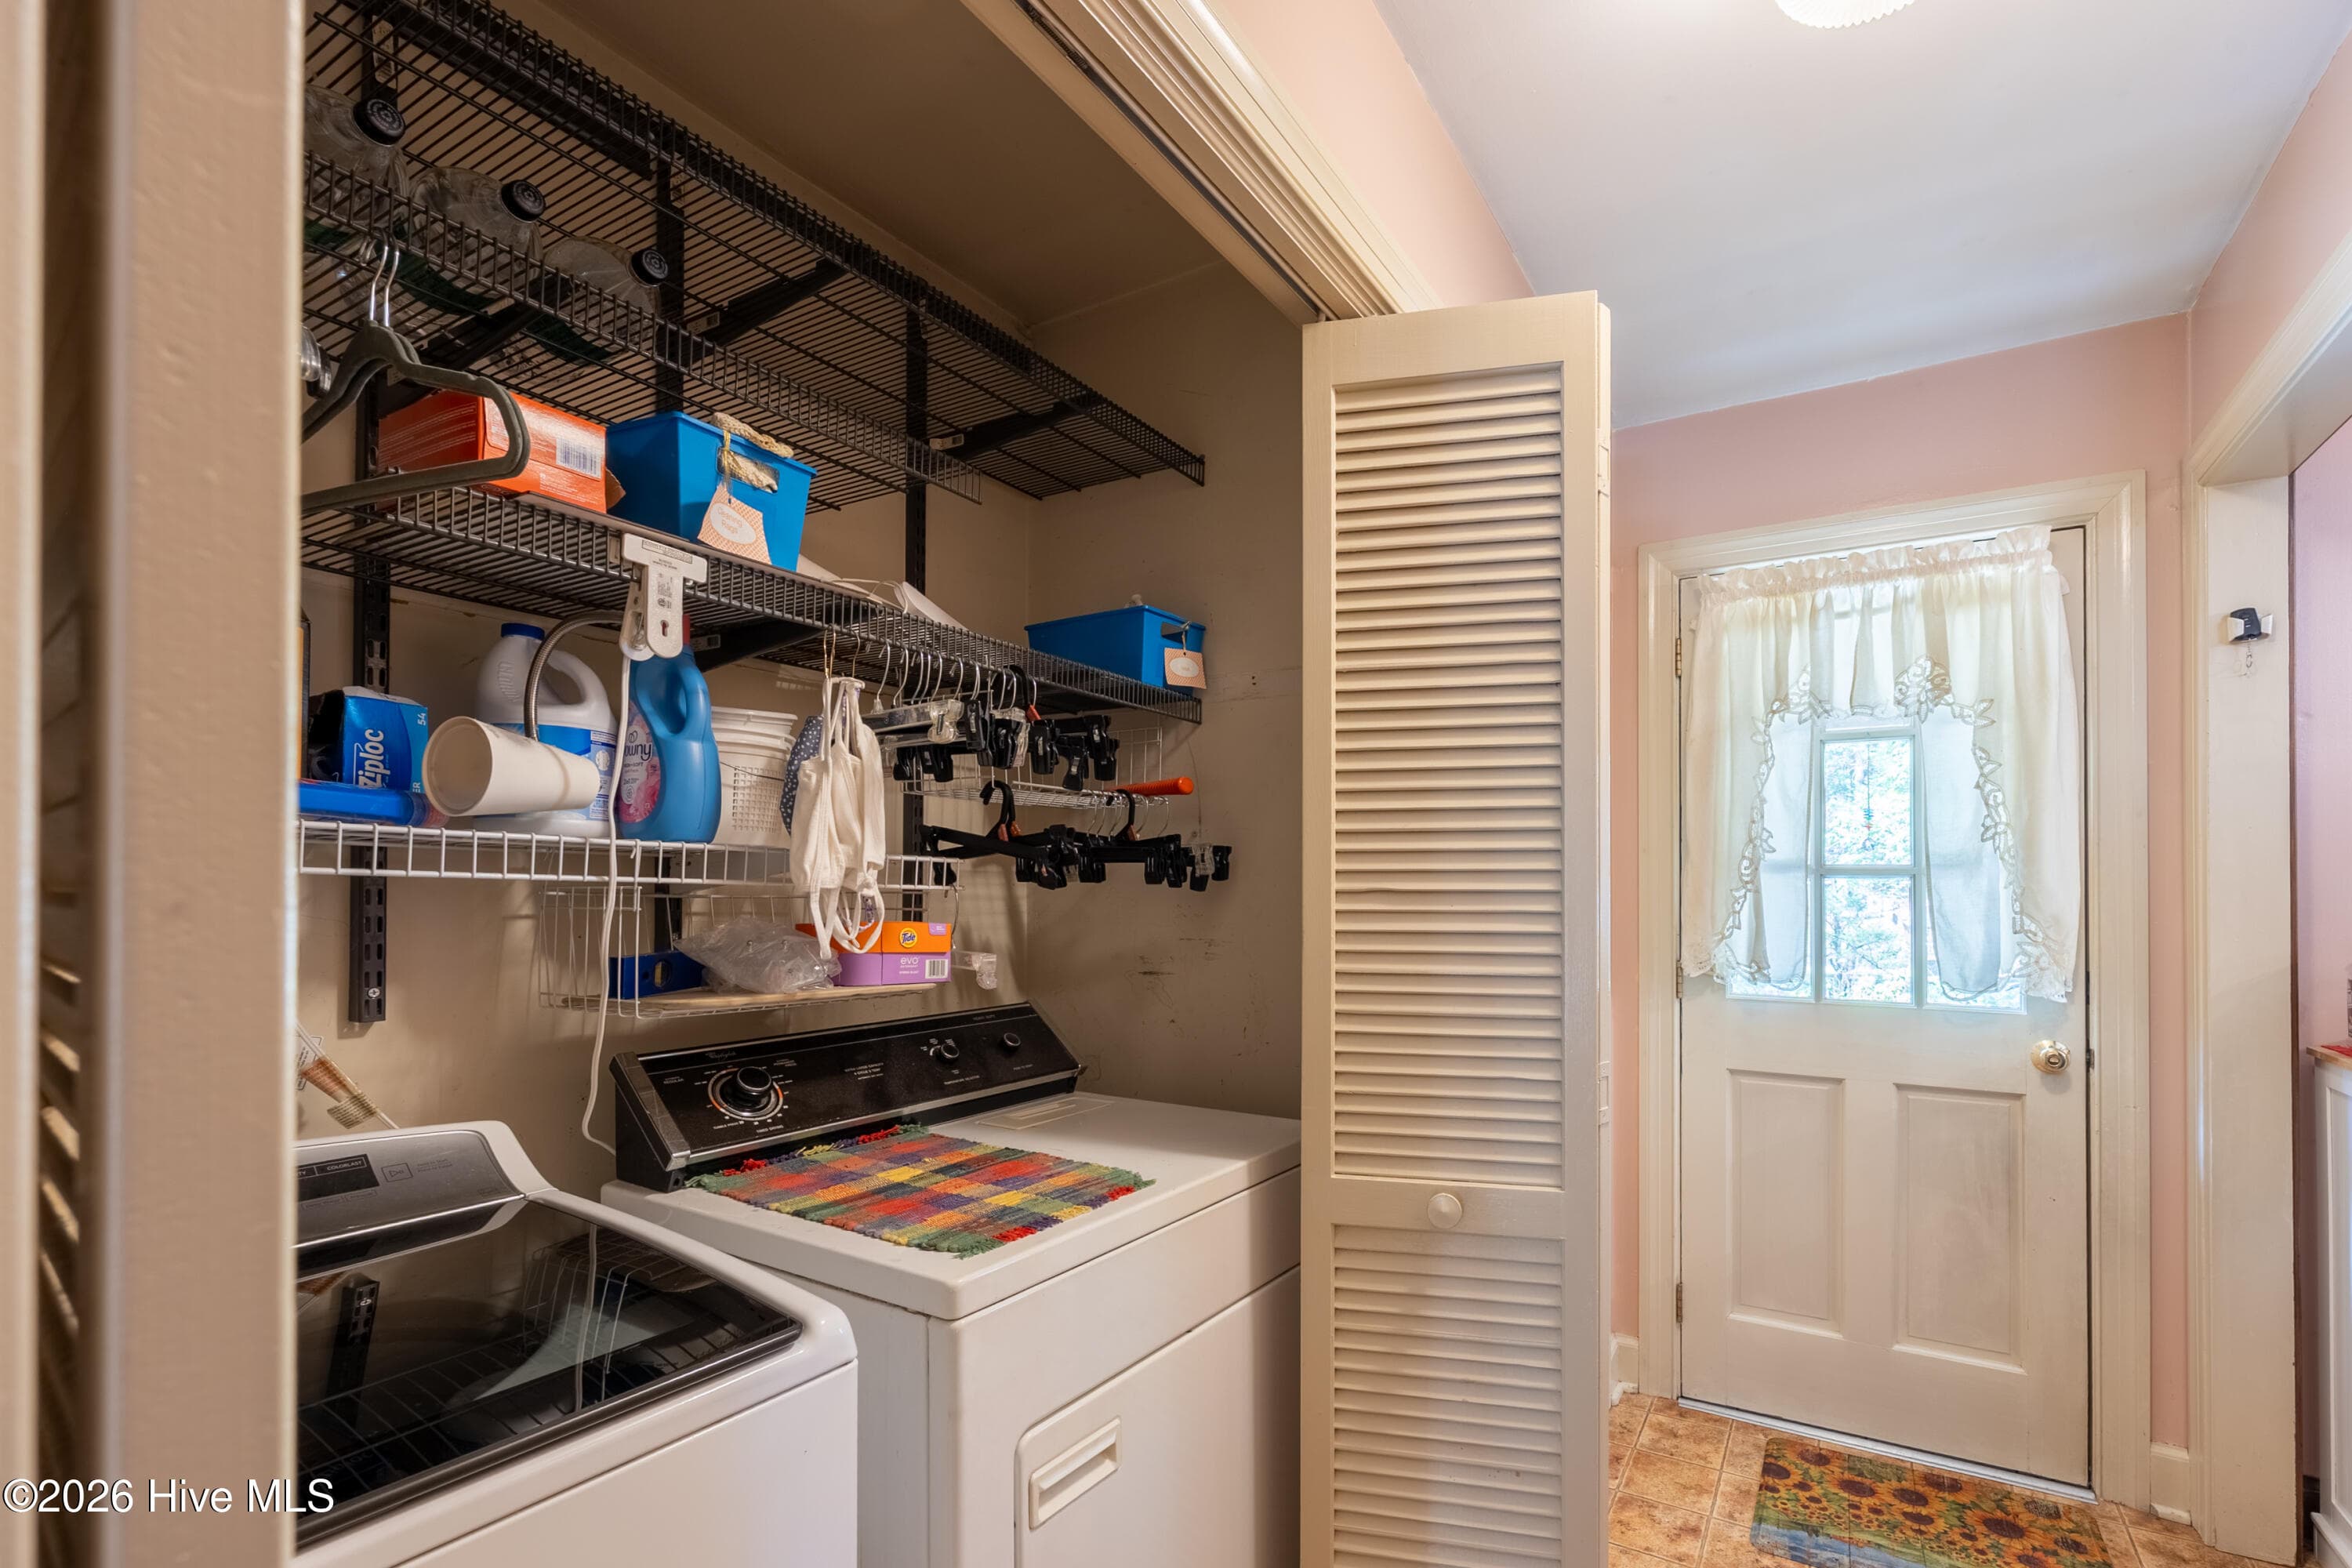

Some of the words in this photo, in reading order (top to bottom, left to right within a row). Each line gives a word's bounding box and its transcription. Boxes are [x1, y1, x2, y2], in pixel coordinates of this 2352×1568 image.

[417, 713, 426, 726] 54
[625, 743, 652, 761] owny
[358, 729, 390, 788] Ziploc
[902, 932, 916, 944] Tide
[900, 956, 919, 965] evo
[326, 1160, 363, 1171] COLORLAST
